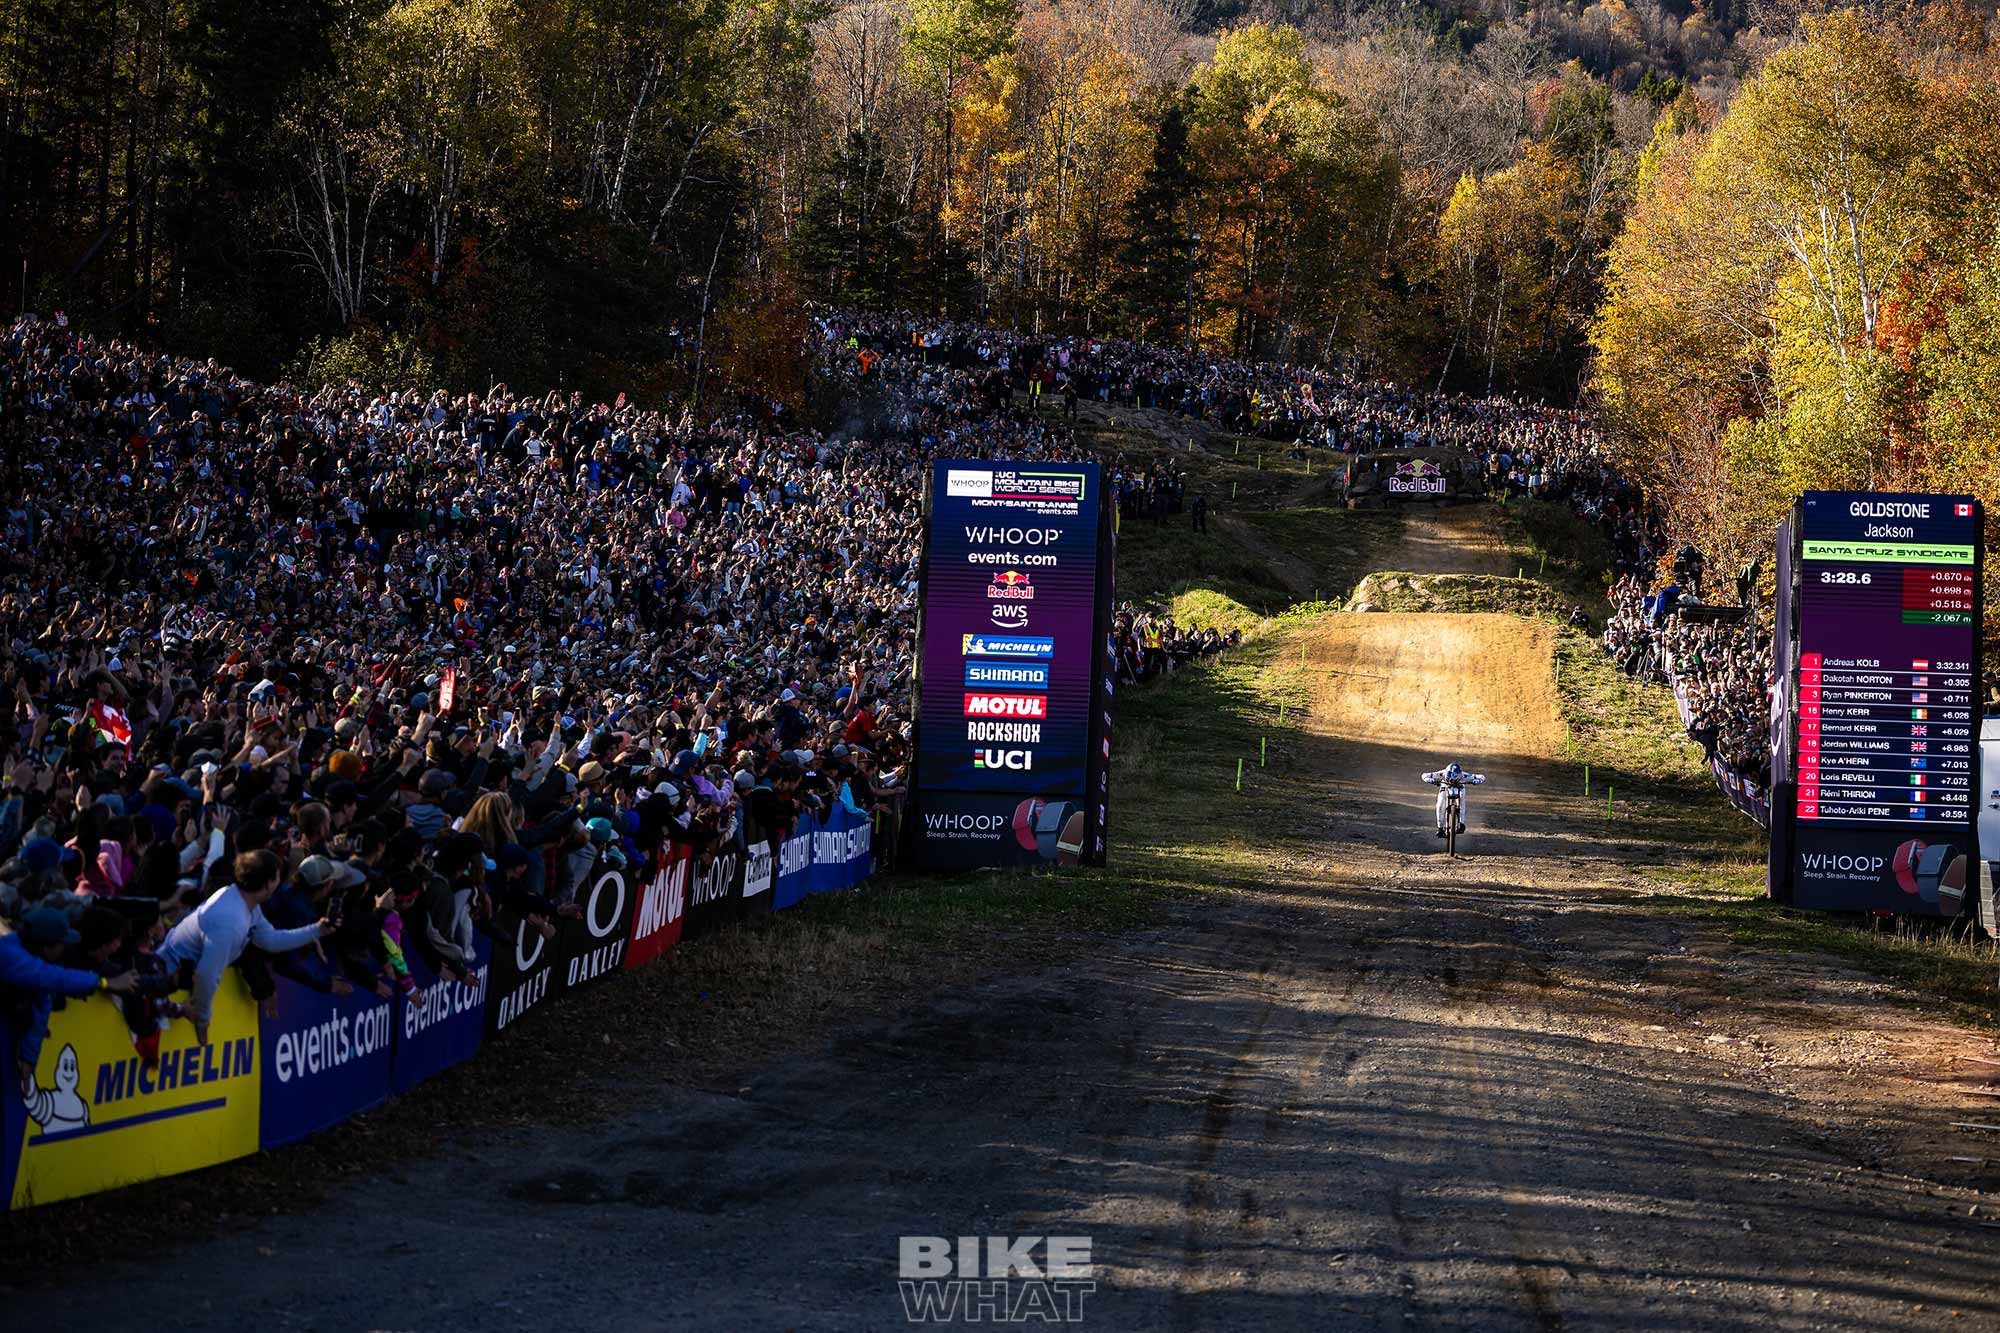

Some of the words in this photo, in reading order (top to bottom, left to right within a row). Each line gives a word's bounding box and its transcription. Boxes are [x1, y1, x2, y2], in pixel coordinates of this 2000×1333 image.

[998, 471, 1016, 479] UCI
[951, 479, 990, 487] WHOOP
[994, 478, 1052, 487] MOUNTAIN
[1054, 480, 1080, 488] BIKE
[994, 485, 1037, 493] WORLD
[1039, 486, 1079, 494] SERIES
[1389, 477, 1417, 492] Red
[1418, 478, 1446, 493] Bull
[1850, 501, 1930, 519] GOLDSTONE
[965, 526, 1059, 545] WHOOP
[1864, 524, 1914, 538] Jackson
[968, 552, 1057, 566] events.com
[1808, 547, 1852, 555] SANTA
[1856, 548, 1893, 556] CRUZ
[1897, 549, 1969, 558] SYNDICATE
[1820, 572, 1872, 585] 3:28.6
[1930, 572, 1962, 582] +0.670
[988, 586, 1011, 598] Red
[1012, 586, 1034, 599] Bull
[1930, 586, 1962, 596] +0.698
[992, 604, 1028, 618] aws
[1930, 600, 1961, 610] +0.518
[1931, 613, 1961, 623] -2.067
[988, 643, 1052, 653] MICHELIN
[1823, 659, 1855, 667] Andreas
[1856, 659, 1880, 668] KOLB
[1936, 662, 1970, 670] 3:32.341
[970, 668, 1045, 682] SHIMANO
[1823, 675, 1855, 684] Dakotah
[1856, 676, 1893, 685] NORTON
[1943, 679, 1970, 687] +0.305
[1822, 691, 1843, 700] Ryan
[1844, 692, 1892, 701] PINKERTON
[1943, 695, 1969, 703] +0.711
[968, 697, 1043, 716] MOTUL
[1822, 708, 1846, 717] Henry
[1847, 708, 1870, 716] KERR
[968, 722, 1041, 743] ROCKSHOX
[1822, 724, 1852, 733] Bernard
[1854, 725, 1877, 733] KERR
[1821, 740, 1848, 749] Jordan
[1849, 741, 1890, 750] WILLIAMS
[984, 750, 1032, 770] UCI
[1807, 756, 1817, 764] 19
[1821, 757, 1837, 767] Kye
[1837, 757, 1870, 766] A'HERN
[1941, 761, 1969, 769] +7.013
[1821, 773, 1840, 782] Loris
[1841, 774, 1875, 783] REVELLI
[1941, 778, 1968, 786] +7.072
[1842, 790, 1876, 799] THIRION
[1820, 806, 1866, 816] Tuhoto-Ariki
[1868, 807, 1891, 817] PENE
[925, 814, 1004, 830] WHOOP
[926, 831, 946, 839] Sleep.
[970, 832, 1001, 840] Recovery
[779, 832, 811, 878] SHIMAN
[1802, 853, 1884, 872] WHOOP
[1803, 871, 1825, 879] Sleep.
[1826, 872, 1848, 880] Strain.
[1849, 873, 1881, 882] Recovery
[635, 858, 687, 940] MOTUL
[568, 937, 625, 987] OAKLEY
[497, 966, 551, 1030] OAKLEY
[275, 1003, 390, 1083] events.com
[94, 1037, 255, 1105] MICHELIN
